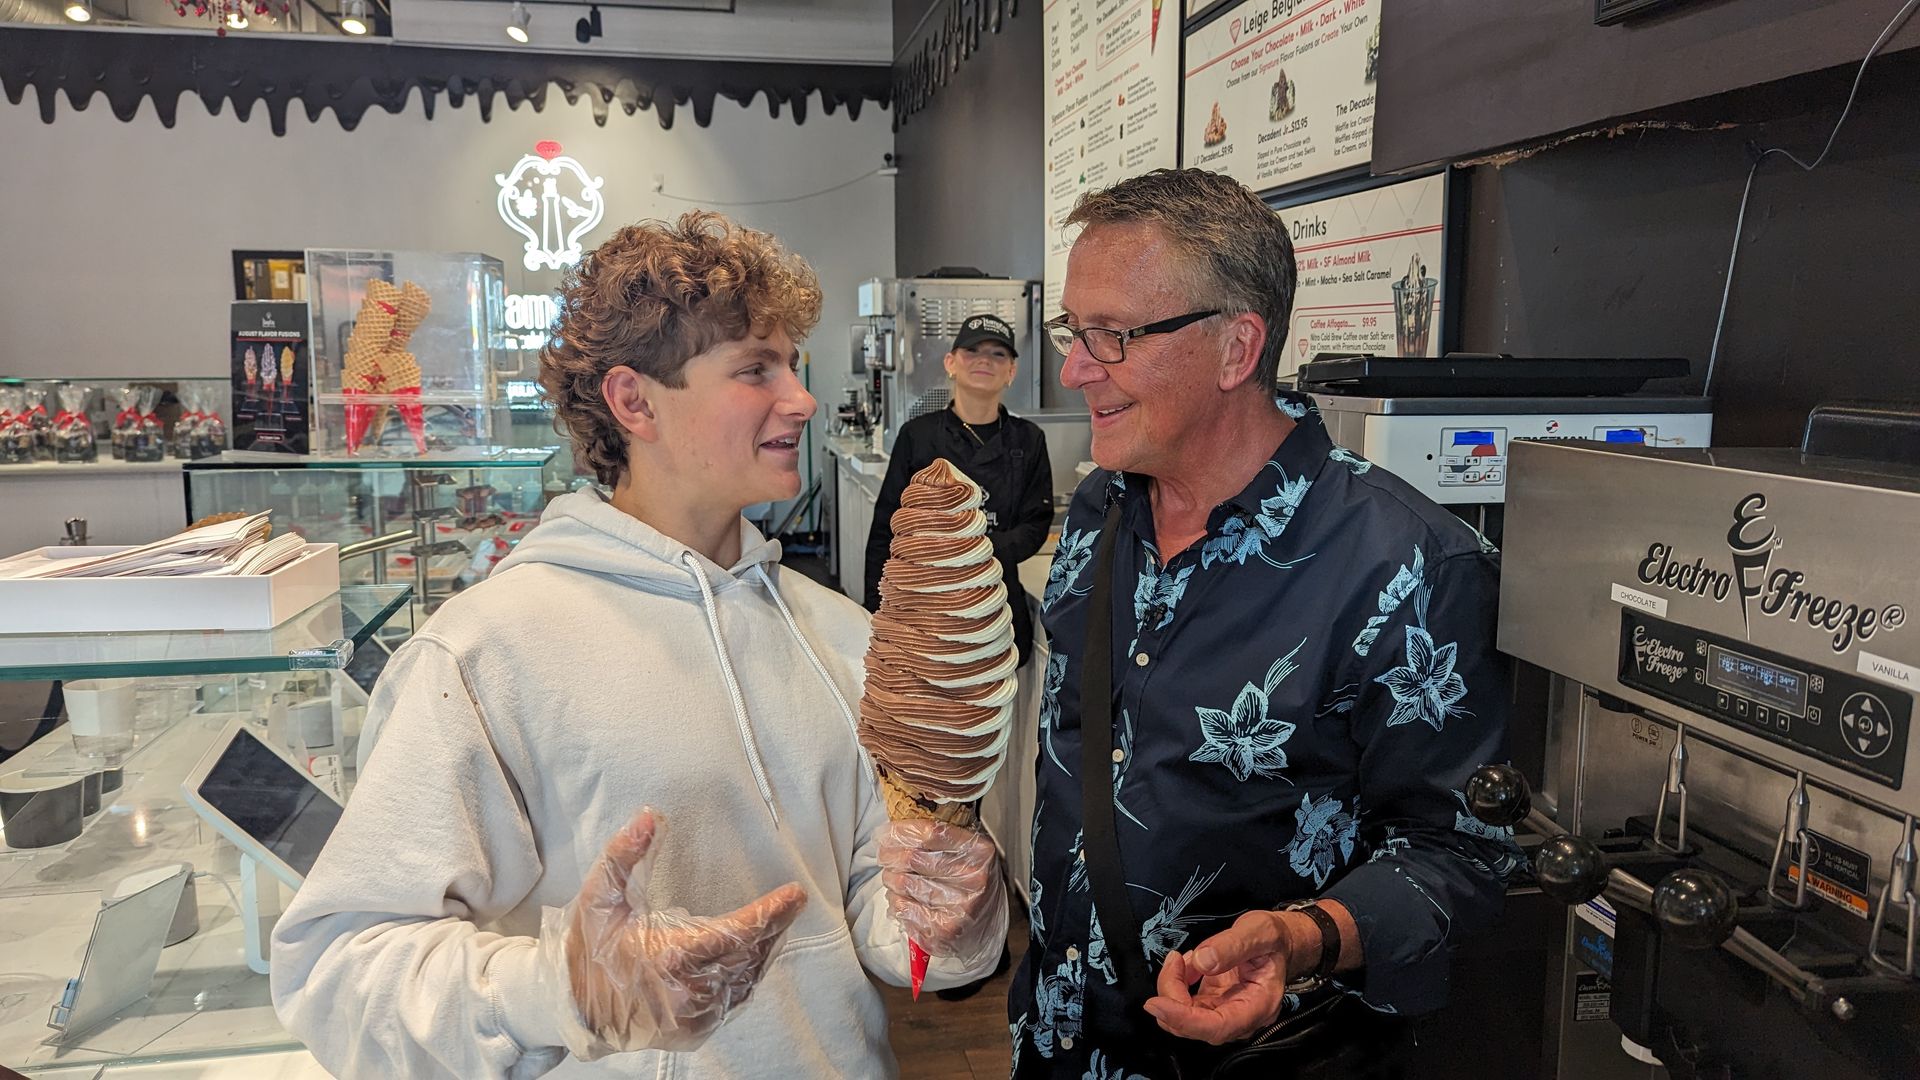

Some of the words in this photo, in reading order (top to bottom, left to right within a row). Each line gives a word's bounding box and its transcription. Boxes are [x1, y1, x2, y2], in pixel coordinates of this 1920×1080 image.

[1243, 10, 1269, 35] Leige
[1231, 55, 1250, 71] Choose
[1251, 47, 1264, 61] Your
[1265, 32, 1294, 54] Chocolate
[1300, 20, 1313, 36] Milk
[1320, 7, 1337, 27] Dark
[1344, 0, 1366, 14] White
[1226, 77, 1240, 89] Choose
[1241, 71, 1250, 82] from
[1259, 58, 1279, 75] Signature
[1280, 50, 1295, 63] Flavor
[1296, 41, 1314, 56] Fusions
[1314, 38, 1321, 48] or
[1321, 29, 1340, 44] Create
[1340, 21, 1354, 34] Your
[1354, 14, 1368, 28] Own
[1335, 104, 1348, 117] The
[1257, 128, 1282, 144] Decadent
[1334, 133, 1351, 144] Waffles
[1351, 126, 1368, 140] dipped
[1257, 150, 1270, 160] Dipped
[1274, 146, 1283, 154] Pure
[1283, 140, 1302, 152] Chocolate
[1302, 136, 1311, 145] with
[1333, 148, 1341, 156] Ice
[1357, 138, 1368, 149] and
[1273, 162, 1289, 175] Whipped
[1289, 161, 1303, 171] Cream
[1275, 155, 1288, 165] Cream
[1288, 152, 1296, 160] and
[1293, 215, 1328, 240] Drinks
[1306, 257, 1319, 270] Milk
[1323, 255, 1332, 268] SF
[1333, 250, 1356, 267] Almond
[1357, 249, 1371, 264] Milk
[1305, 277, 1316, 287] Mint
[1320, 274, 1338, 286] Mocha
[1342, 273, 1353, 283] Sea
[1353, 270, 1365, 282] Salt
[1366, 266, 1392, 281] Caramel
[1310, 319, 1326, 329] Coffee
[1362, 316, 1377, 328] $9.95
[1321, 332, 1330, 341] Cold
[1331, 332, 1342, 341] Brew
[1343, 331, 1358, 341] Coffee
[1359, 333, 1369, 341] over
[1370, 331, 1380, 341] Soft
[1380, 331, 1395, 341] Serve
[1332, 342, 1341, 351] with
[1342, 342, 1361, 352] Premium
[1362, 341, 1387, 351] Chocolate
[1637, 542, 1736, 603] Electro
[1620, 591, 1658, 610] CHOCOLATE
[1646, 637, 1686, 664] Electro
[1872, 661, 1910, 681] VANILLA
[1632, 732, 1649, 743] POWER
[1833, 863, 1860, 880] VERTICAL
[1811, 876, 1853, 904] WARNING
